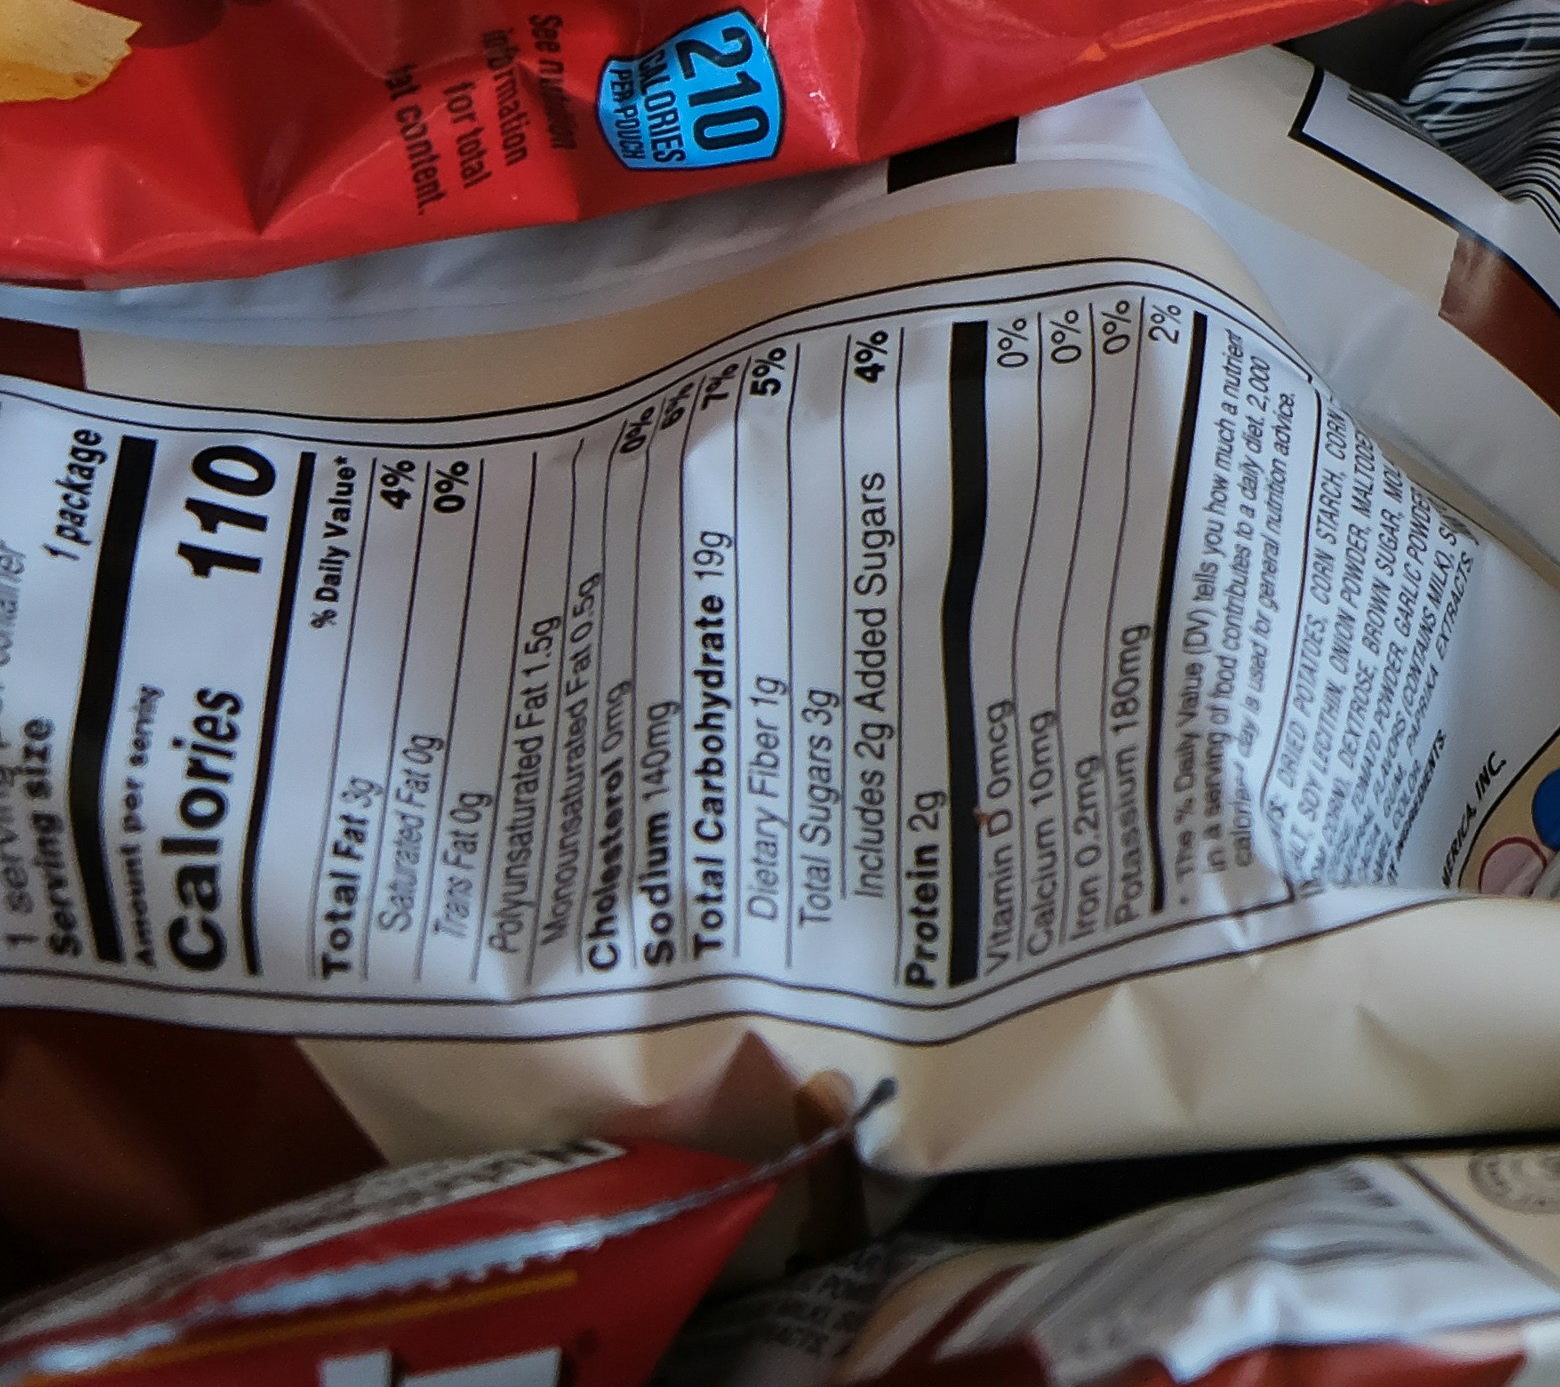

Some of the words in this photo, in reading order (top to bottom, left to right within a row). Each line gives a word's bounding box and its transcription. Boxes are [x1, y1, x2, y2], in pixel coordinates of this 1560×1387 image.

[639, 49, 686, 165] CALORIES
[676, 27, 770, 151] 210
[178, 445, 278, 580] 110
[696, 529, 734, 587] 19g
[693, 593, 727, 842] Carbohydrate
[159, 685, 245, 975] Calories
[907, 791, 942, 822] 2g
[693, 854, 726, 959] Total
[907, 831, 939, 989] Protein
